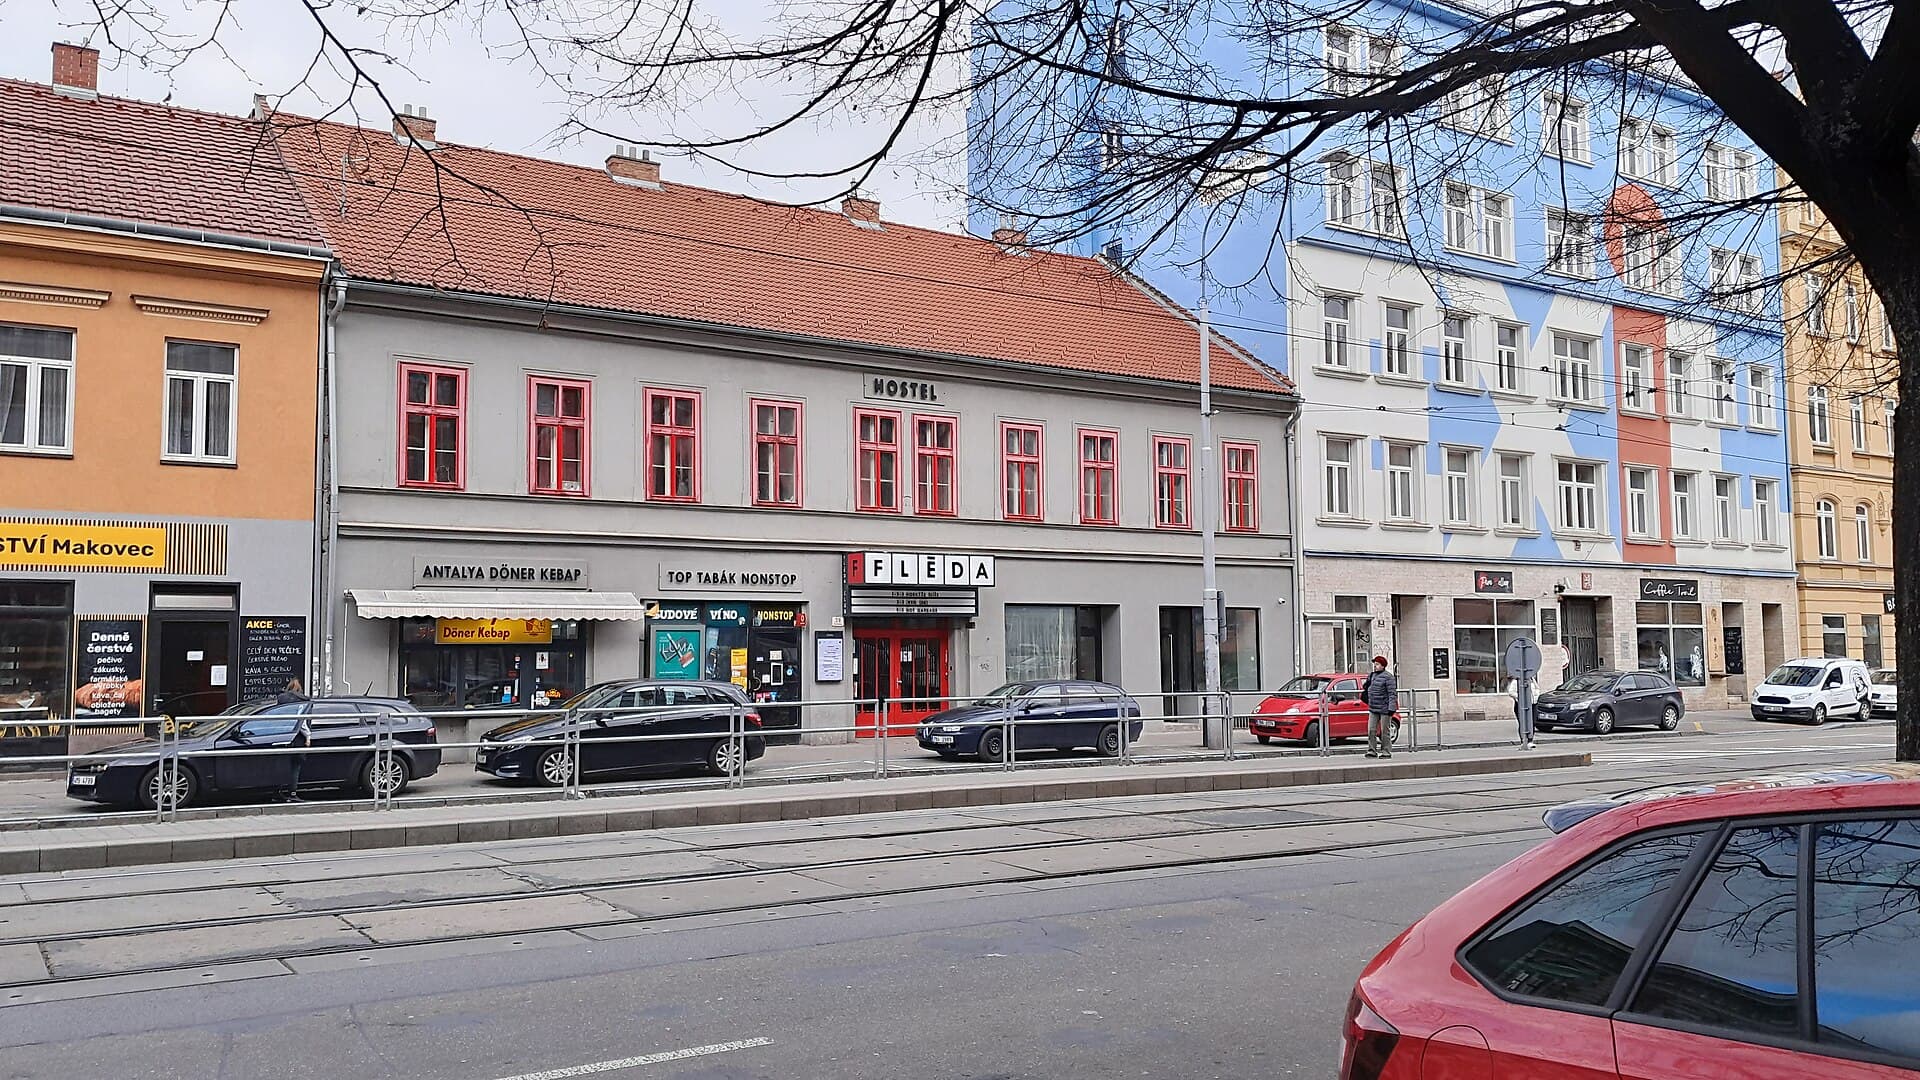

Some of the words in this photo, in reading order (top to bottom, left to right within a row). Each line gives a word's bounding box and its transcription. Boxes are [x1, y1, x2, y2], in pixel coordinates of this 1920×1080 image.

[874, 378, 937, 401] HOSTEL
[53, 539, 154, 556] Makovec
[422, 565, 485, 579] ANTALYA
[489, 564, 535, 580] DÖNER
[540, 568, 582, 581] KEBAP
[668, 571, 692, 583] TOP
[697, 570, 736, 584] TABÁK
[741, 573, 797, 585] NONSTOP
[709, 608, 738, 620] VÍNO
[757, 610, 794, 621] NONSTOP
[246, 620, 273, 629] AKCE
[91, 632, 130, 642] Denně
[443, 626, 475, 638] Döner
[478, 627, 510, 641] Kebap
[86, 643, 133, 653] čerstvé
